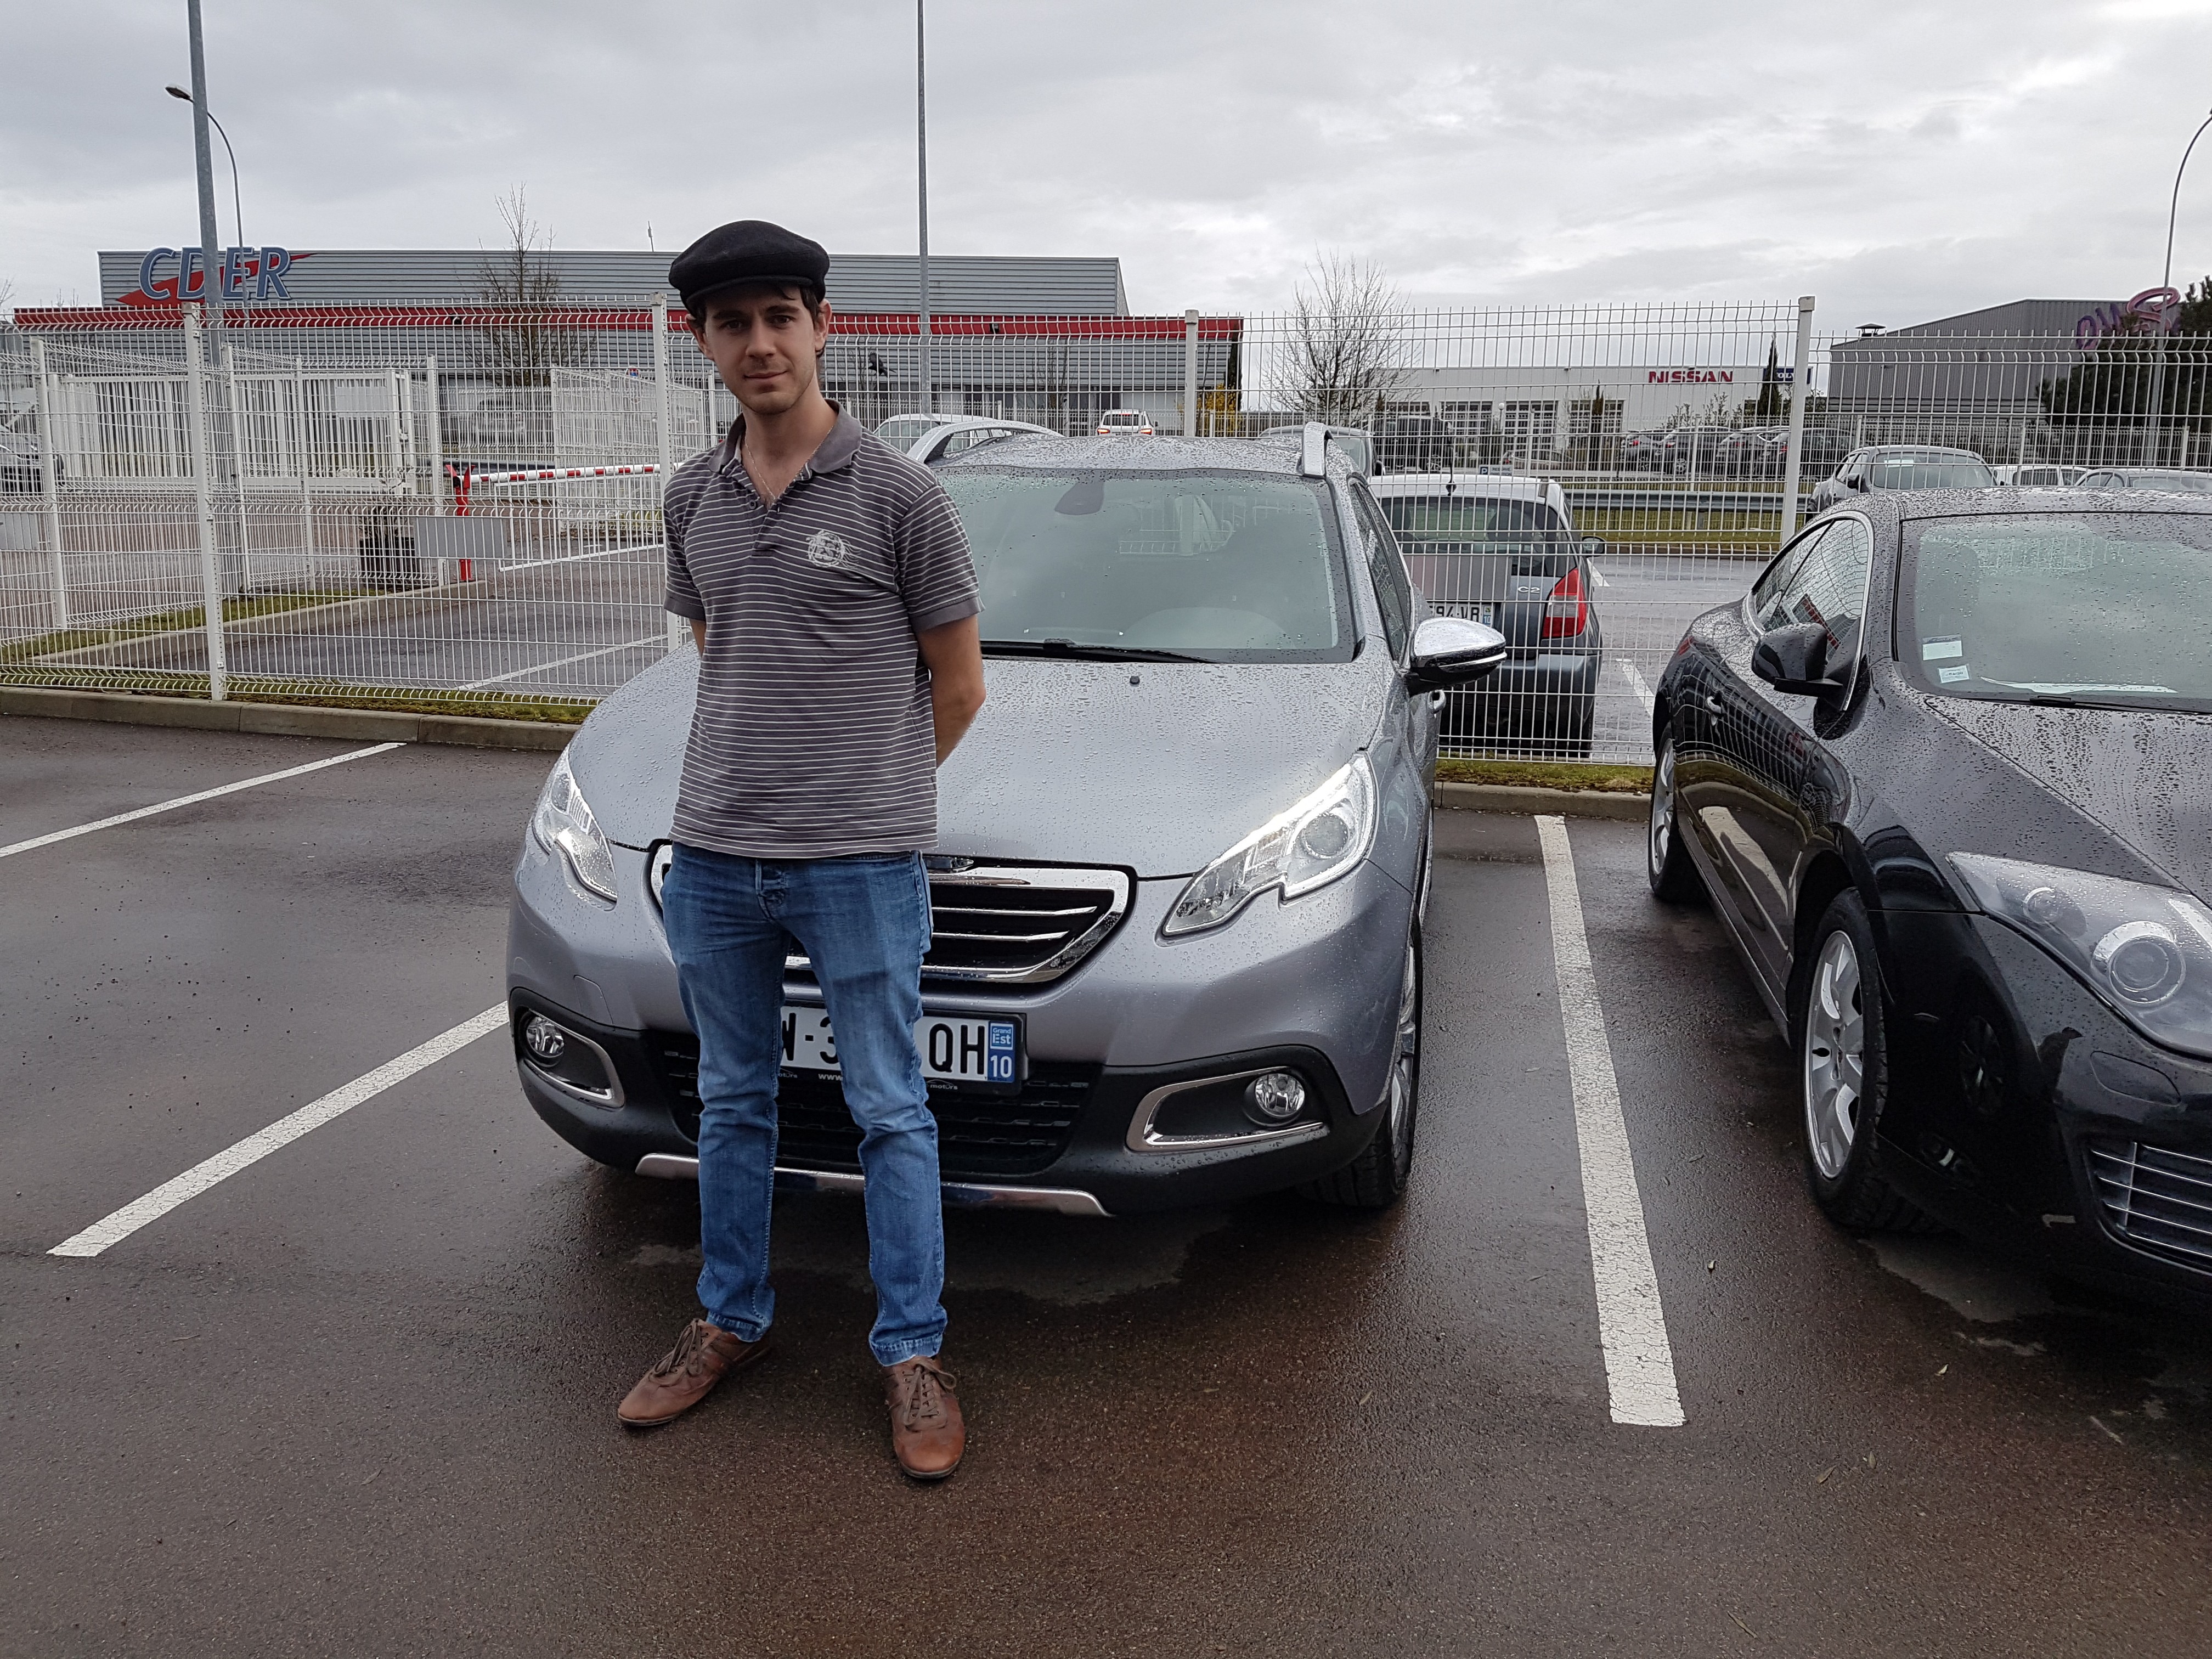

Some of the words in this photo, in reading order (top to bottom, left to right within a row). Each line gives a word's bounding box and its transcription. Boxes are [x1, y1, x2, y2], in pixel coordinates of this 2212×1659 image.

[139, 246, 292, 300] CDER
[1649, 371, 1734, 383] NISSAN
[992, 1032, 1012, 1045] Est
[990, 1055, 1012, 1078] 10
